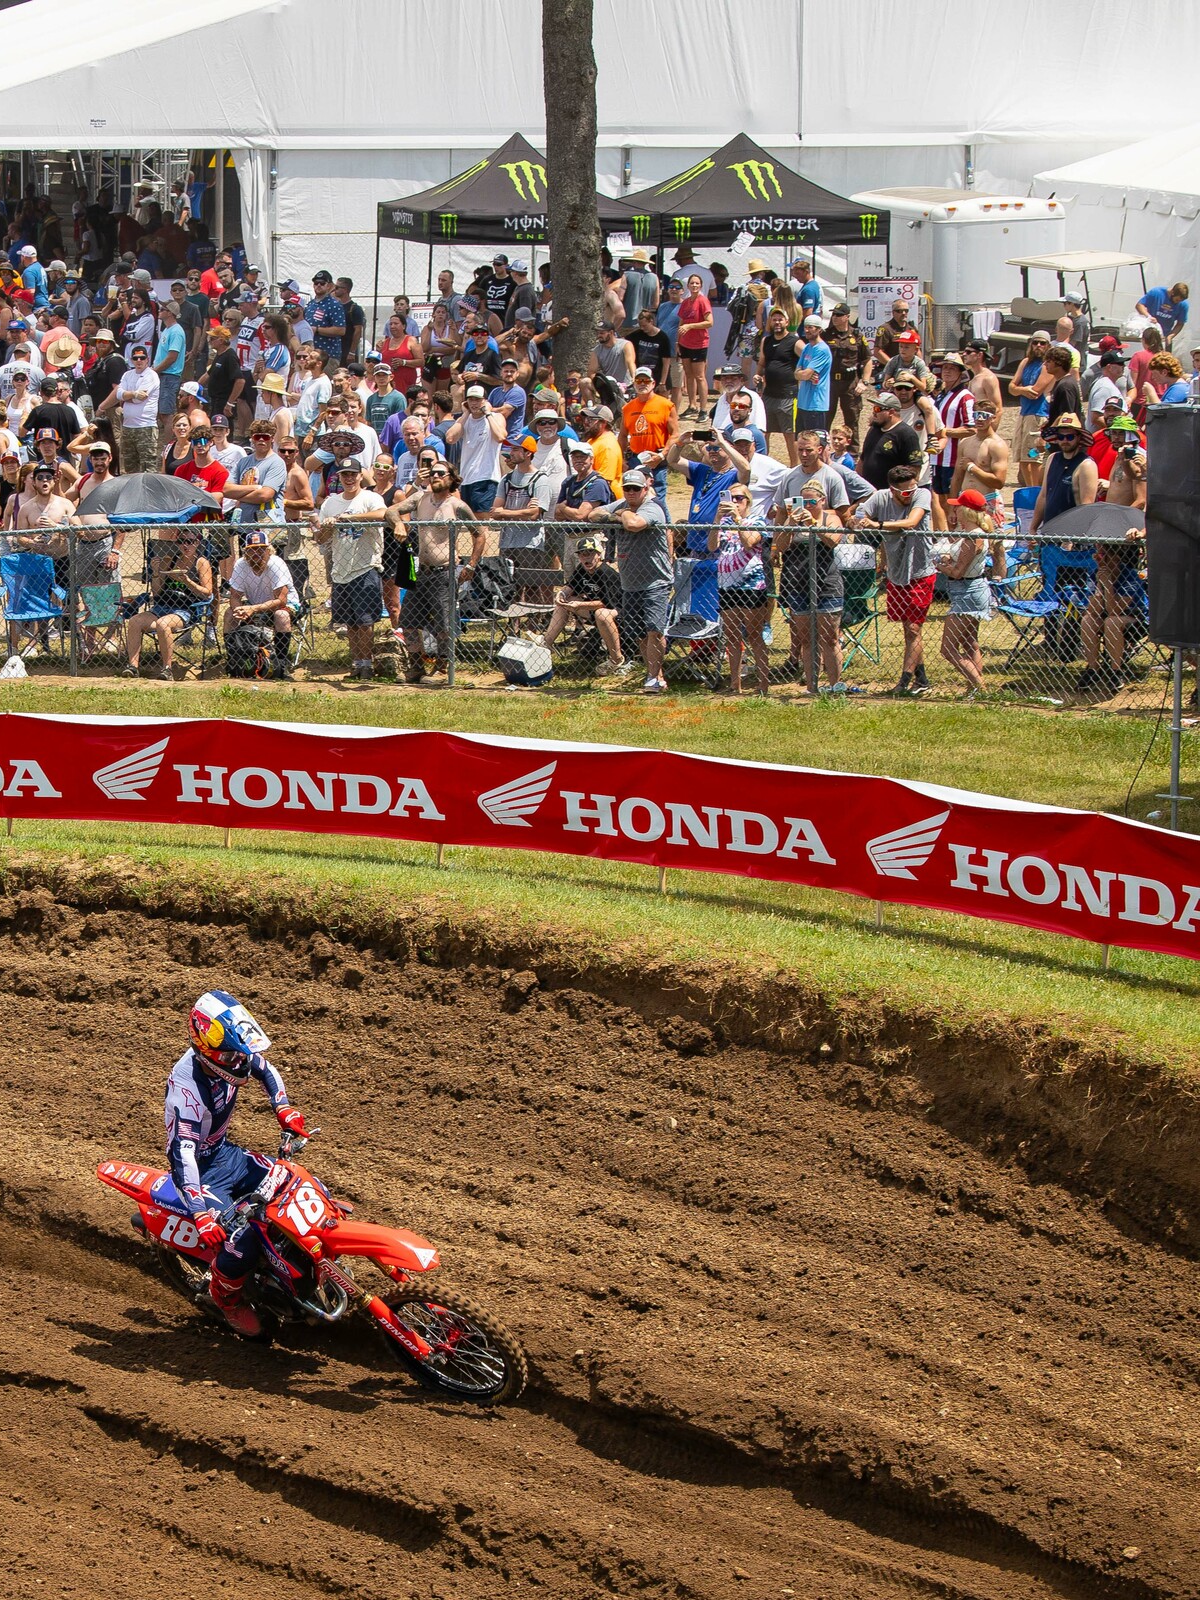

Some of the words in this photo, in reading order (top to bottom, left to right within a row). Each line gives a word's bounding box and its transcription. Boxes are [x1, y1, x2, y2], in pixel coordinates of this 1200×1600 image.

[504, 215, 549, 231] MON
[732, 216, 820, 233] MONSTER
[1156, 311, 1172, 319] STAFF
[173, 764, 446, 820] HONDA
[559, 790, 837, 865] HONDA
[286, 1181, 324, 1236] 18
[160, 1214, 199, 1248] 18
[321, 1264, 356, 1295] SHOWA
[379, 1317, 419, 1352] DUNLOP
